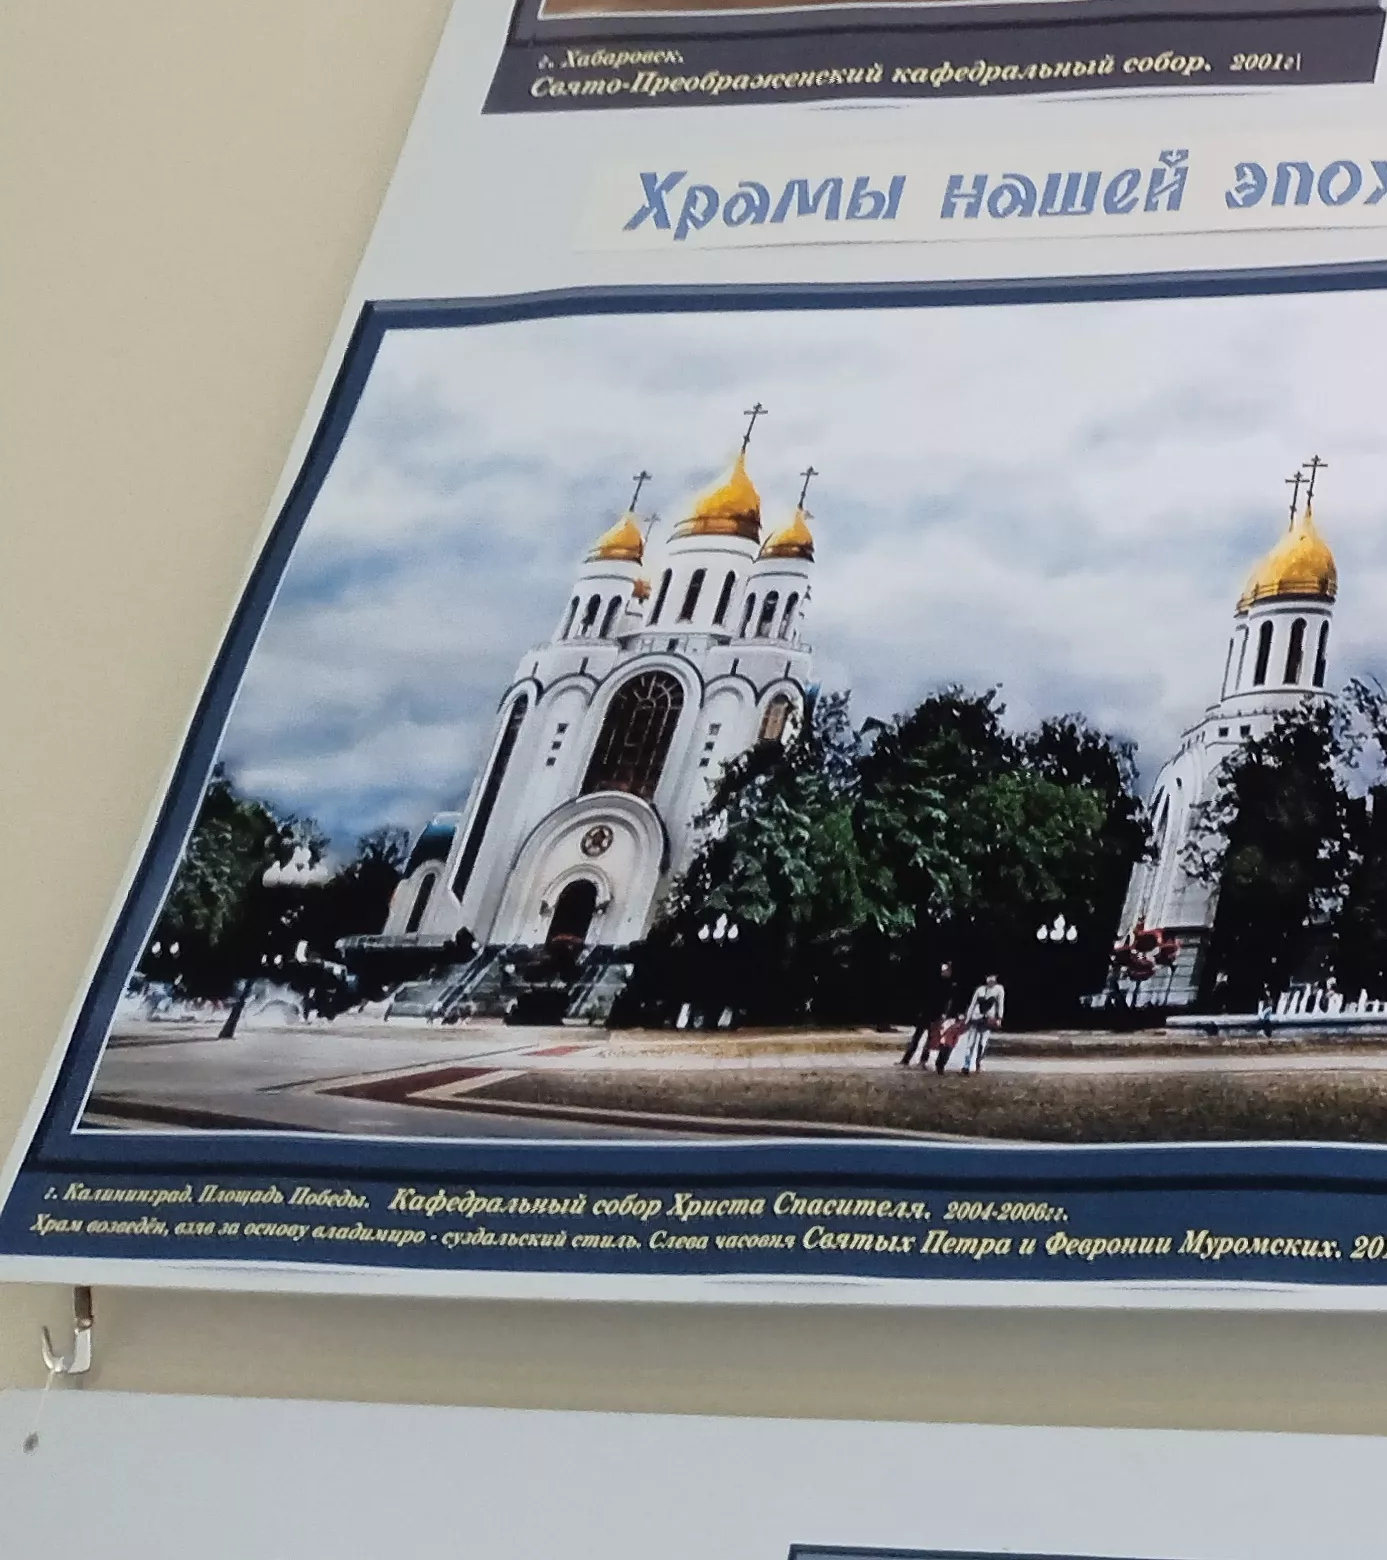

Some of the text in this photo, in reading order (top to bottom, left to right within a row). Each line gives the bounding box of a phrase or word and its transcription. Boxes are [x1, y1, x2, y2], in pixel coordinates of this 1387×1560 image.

[530, 64, 883, 97] Свято-Преображенский
[892, 54, 1115, 88] кафедральный
[1122, 50, 1212, 76] собор.
[623, 170, 907, 240] Храмы
[940, 149, 1189, 217] нашей
[63, 1184, 194, 1204] Калининград.
[198, 1184, 282, 1206] Площадь
[288, 1186, 371, 1209] Победы.
[387, 1187, 586, 1216] Кафедральный
[591, 1195, 662, 1222] собор
[666, 1193, 764, 1221] Христа
[773, 1192, 931, 1221] Спасителя.
[943, 1201, 1070, 1223] 2004-2006гг.
[30, 1214, 82, 1236] Храм
[218, 1221, 239, 1236] за
[243, 1220, 309, 1242] основу
[312, 1223, 426, 1247] владимиро
[441, 1227, 566, 1250] суздальский
[572, 1231, 643, 1250] стиль.
[649, 1230, 708, 1251] Слева
[715, 1231, 795, 1250] часовня
[802, 1224, 916, 1252] Святых
[920, 1230, 1013, 1259] Петра
[1018, 1237, 1035, 1254] и
[1045, 1231, 1173, 1262] Февронии
[1178, 1229, 1343, 1264] Муромских.
